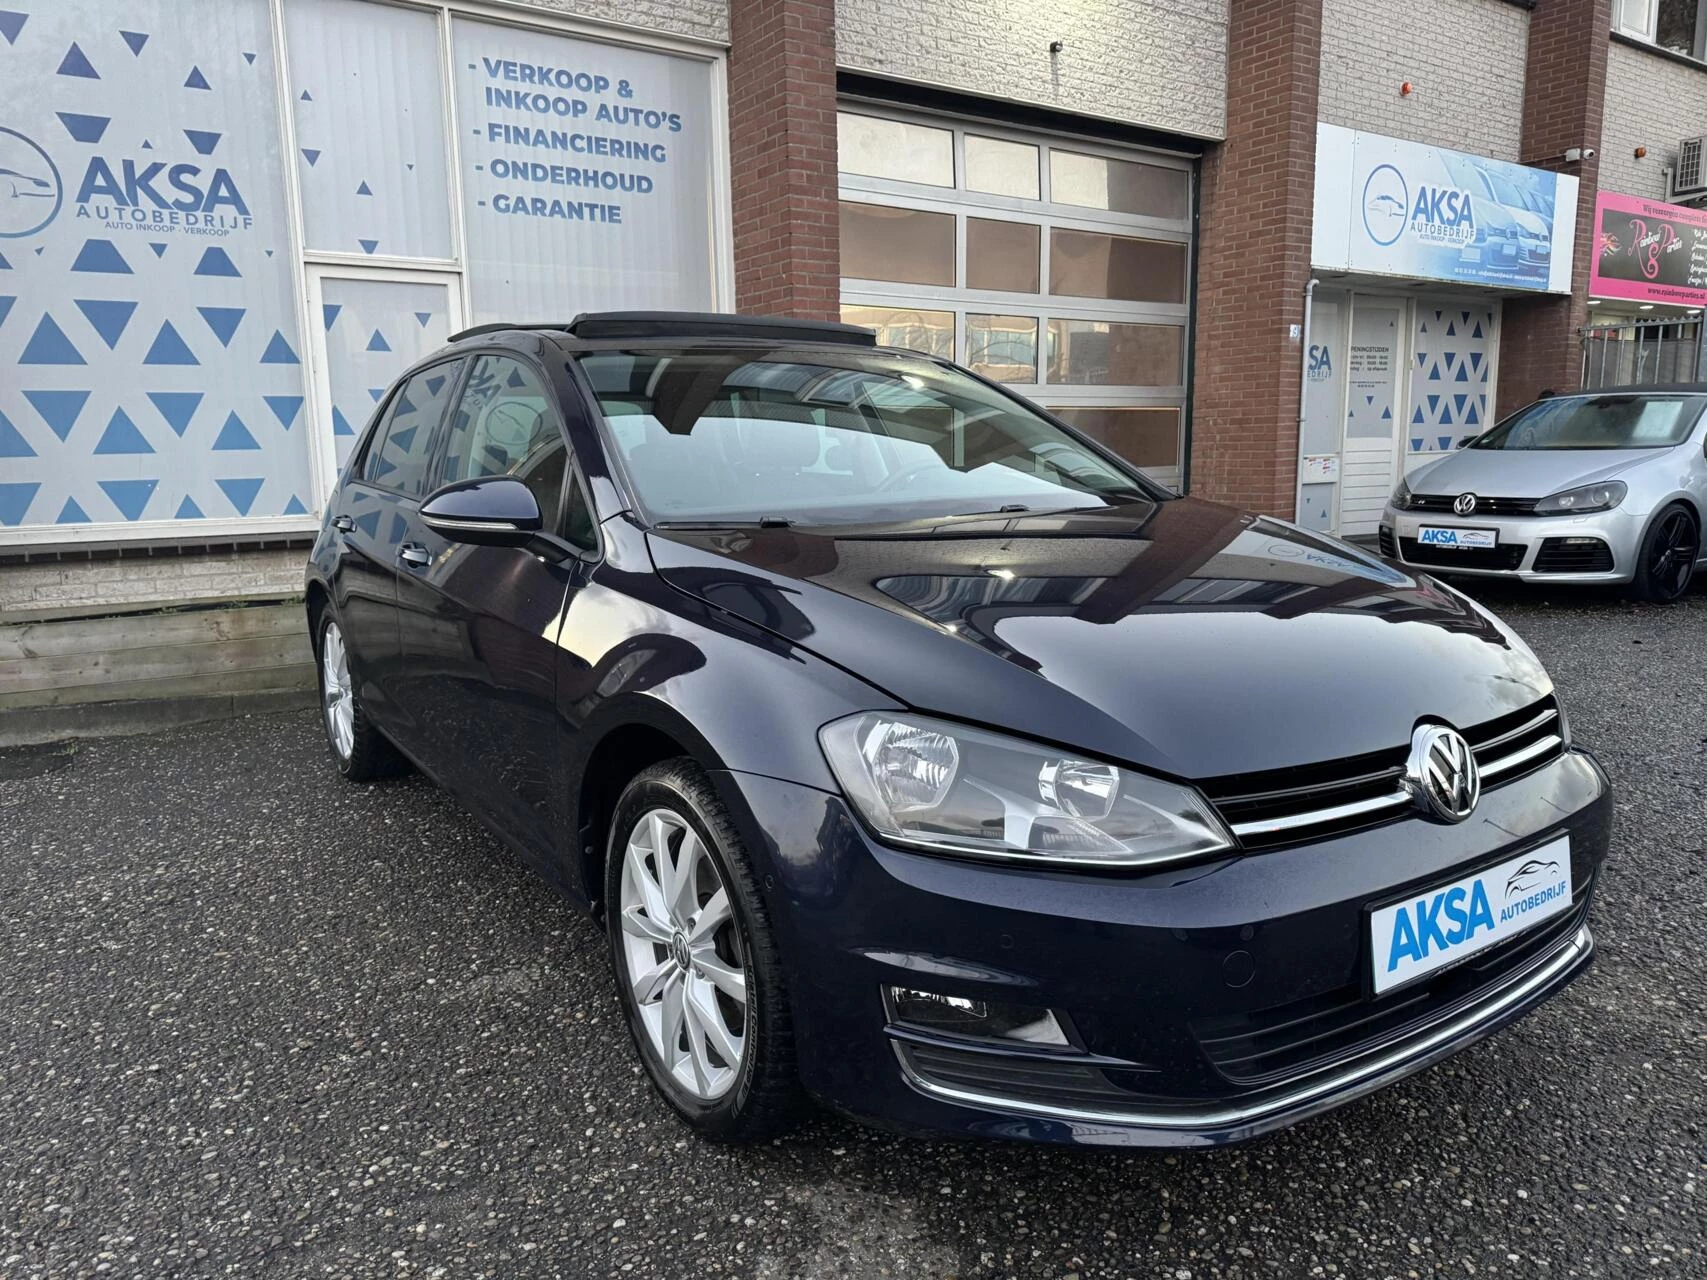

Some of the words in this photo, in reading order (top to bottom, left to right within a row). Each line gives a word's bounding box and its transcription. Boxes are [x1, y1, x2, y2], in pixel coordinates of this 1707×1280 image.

[482, 57, 609, 94] VERKOOP
[617, 79, 633, 98] &
[485, 86, 587, 118] INKOOP
[595, 103, 682, 132] AUTO'S
[488, 122, 666, 163] FINANCIERING
[75, 156, 251, 216] AKSA
[490, 158, 653, 194] ONDERHOUD
[76, 204, 253, 230] AUTOBEDRIJF
[492, 193, 622, 224] GARANTIE
[1411, 186, 1474, 229] AKSA
[104, 221, 133, 230] AUTO
[135, 222, 175, 233] INKOOP
[183, 227, 230, 237] VERKOOP
[1410, 222, 1475, 240] AUTOBEDRIJF
[1308, 345, 1332, 370] SA
[1422, 529, 1458, 544] AKSA
[1500, 880, 1567, 923] AUTOBEDRIJF
[1387, 879, 1496, 973] AKSA
